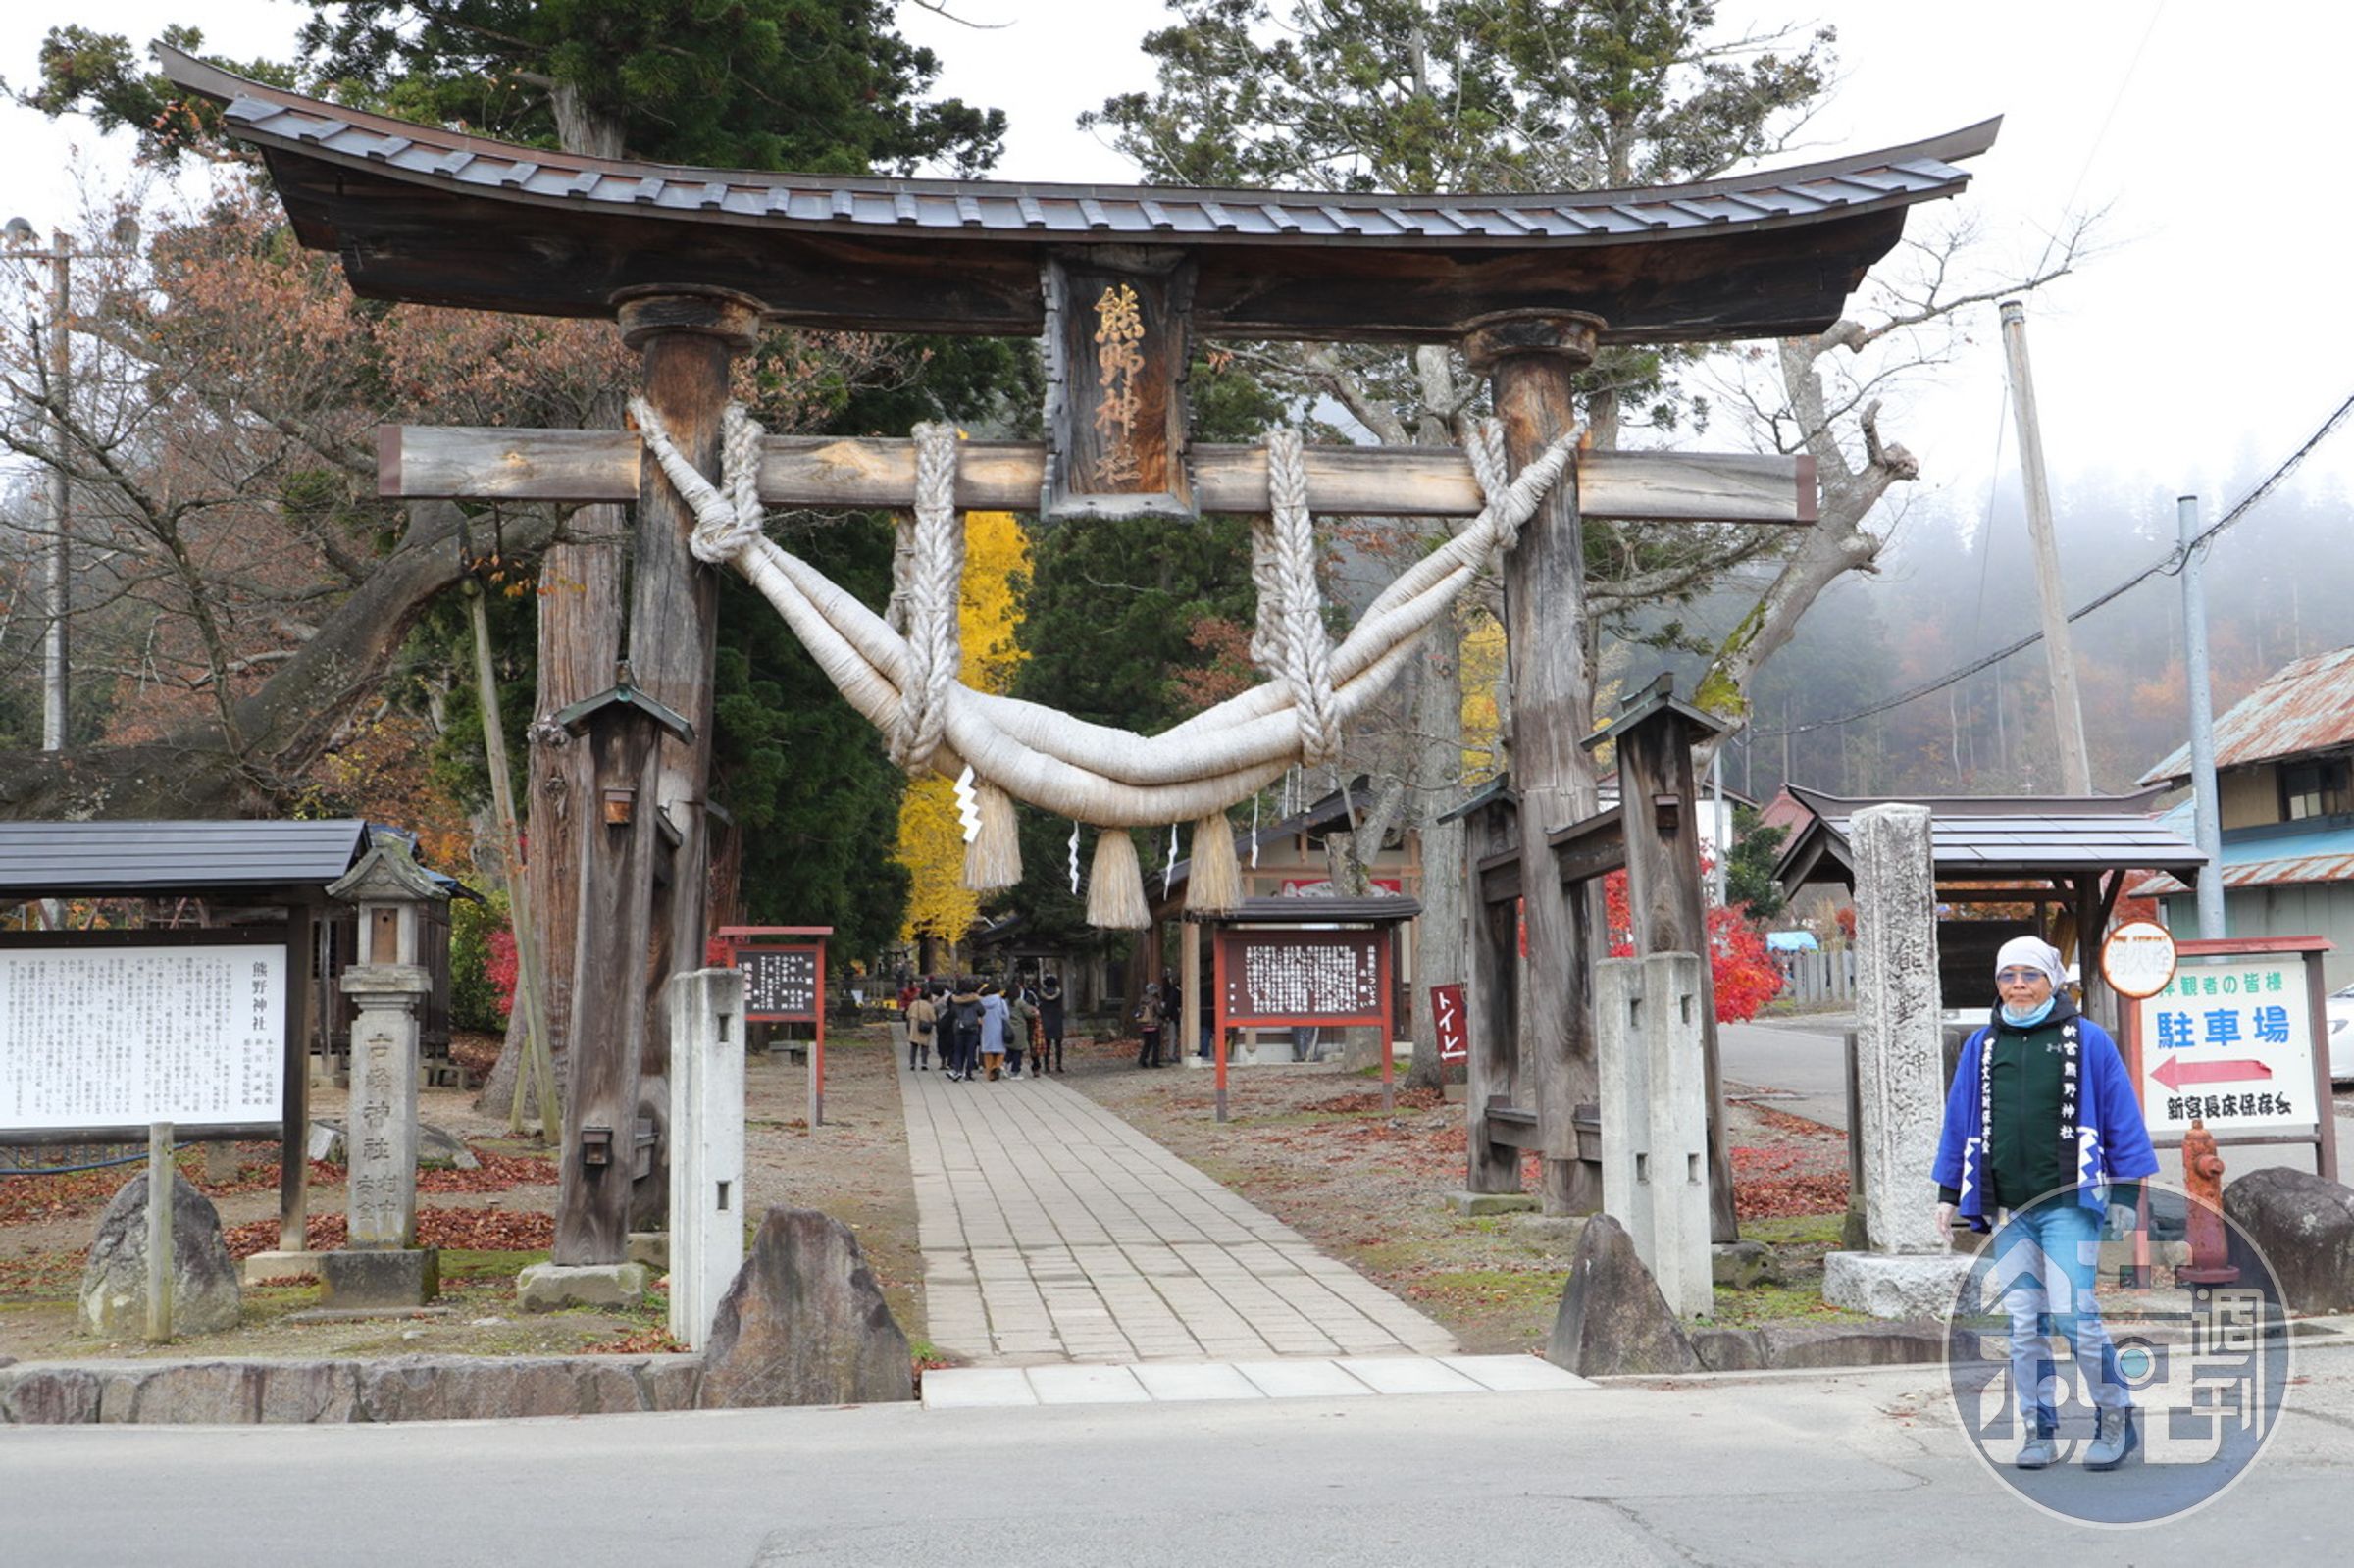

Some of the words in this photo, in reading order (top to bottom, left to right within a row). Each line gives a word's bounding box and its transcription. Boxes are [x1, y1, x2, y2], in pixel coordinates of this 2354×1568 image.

[1093, 283, 1146, 486] 熊野神社
[2109, 943, 2171, 975] 消火栓
[251, 960, 268, 1031] 熊野神社
[1438, 991, 1459, 1051] トイレ
[2156, 1005, 2290, 1050] 駐車場
[2060, 1025, 2078, 1140] 新宮熊野神社
[356, 1174, 376, 1221] 安全
